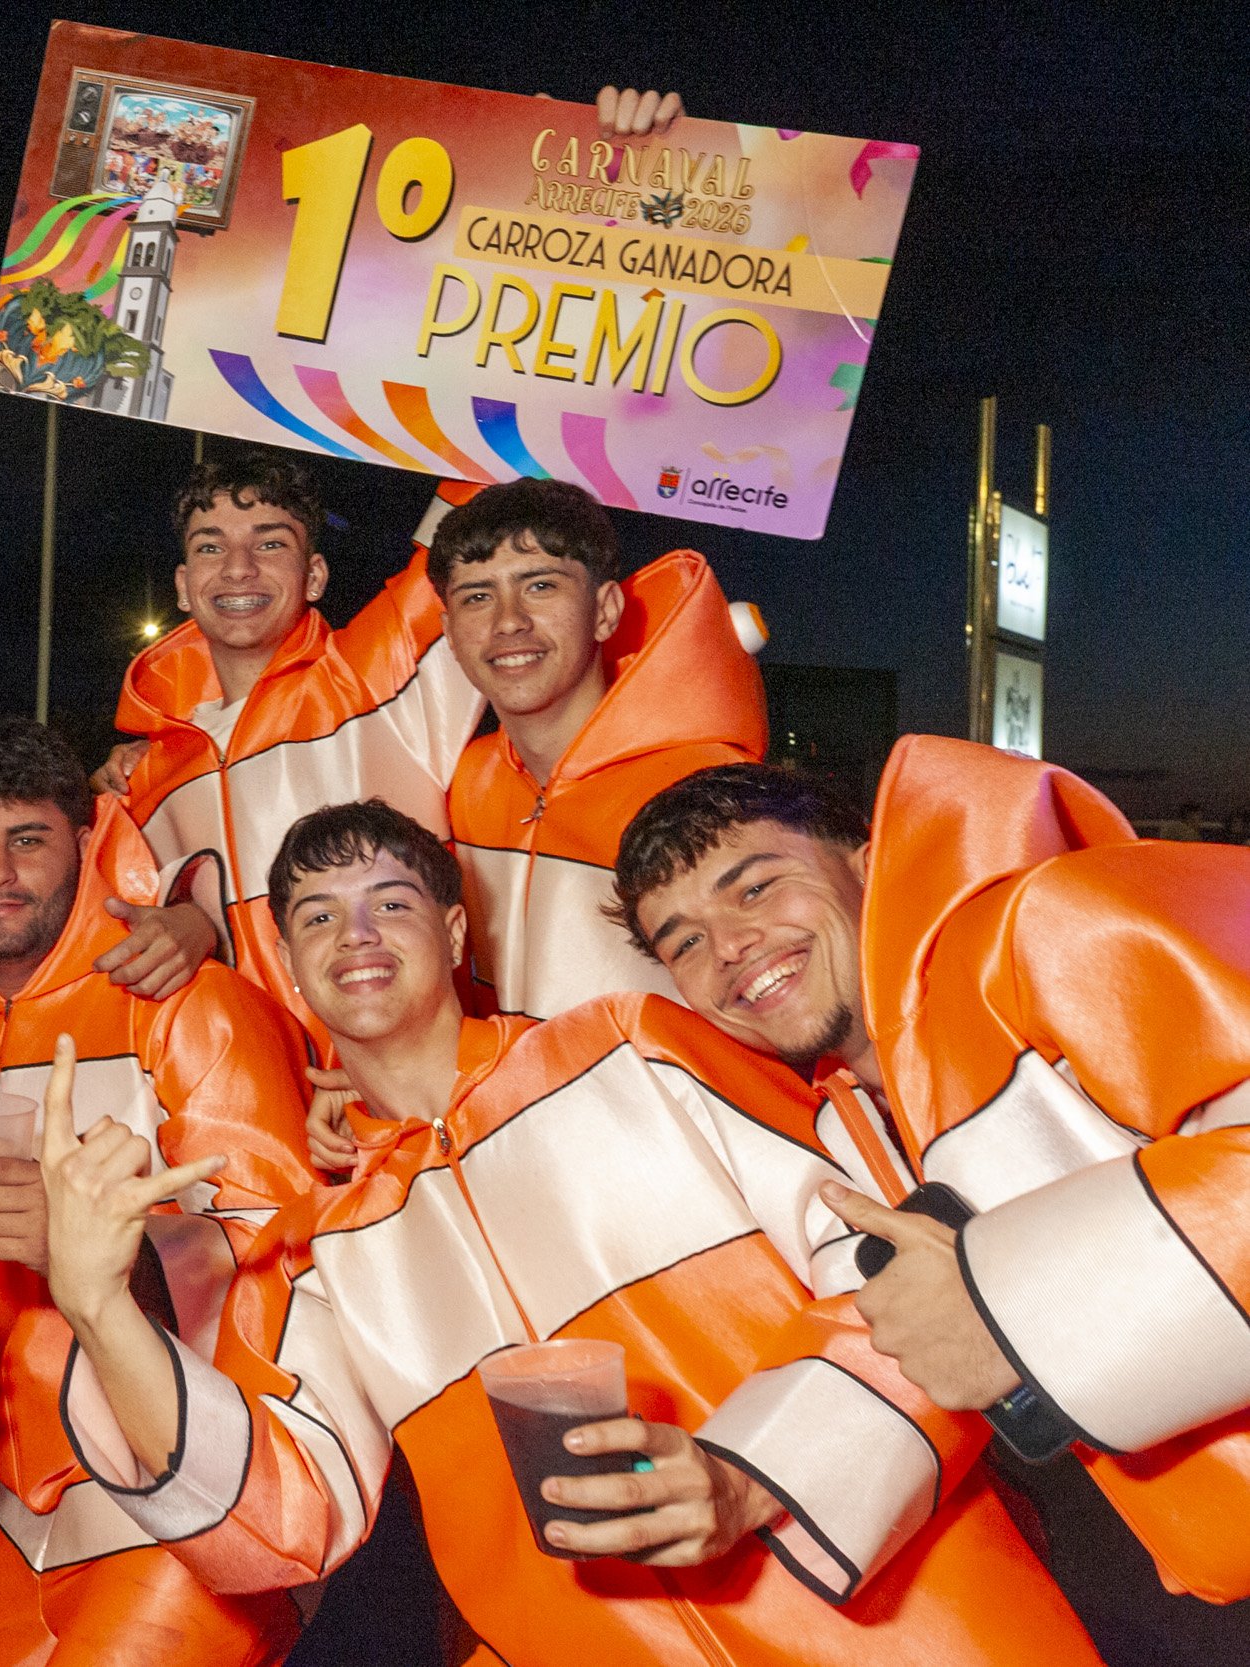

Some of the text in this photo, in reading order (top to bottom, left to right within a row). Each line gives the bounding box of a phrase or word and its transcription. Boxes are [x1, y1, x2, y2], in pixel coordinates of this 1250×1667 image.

[531, 128, 755, 200] CARNAVAL
[525, 174, 751, 235] ARRECIFE 2026
[467, 215, 793, 299] CARROZA GANADORA
[415, 263, 783, 408] PREMIO
[690, 471, 790, 510] arrecife
